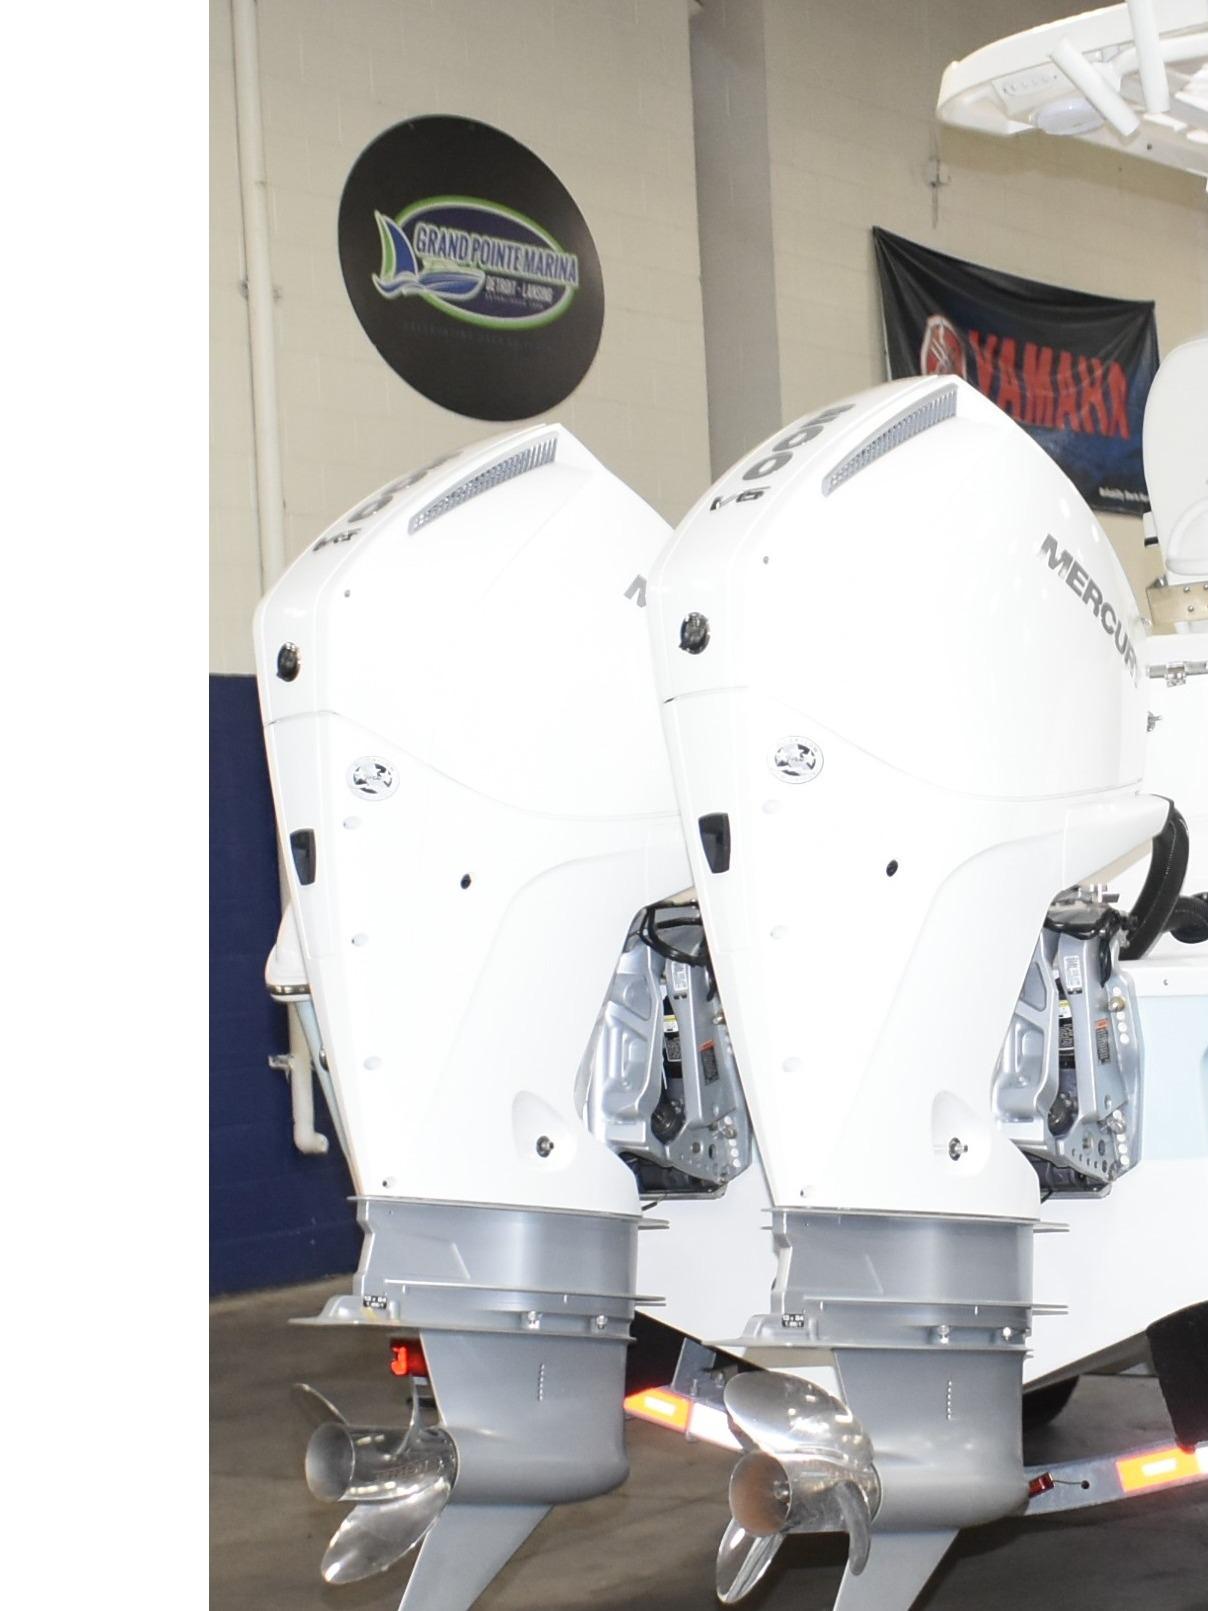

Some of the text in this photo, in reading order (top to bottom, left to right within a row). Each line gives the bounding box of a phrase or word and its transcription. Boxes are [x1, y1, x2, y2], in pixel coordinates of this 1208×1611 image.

[415, 223, 578, 285] GRAND POINTE MARINA
[968, 329, 1130, 441] YAMAHA
[1039, 533, 1139, 686] MERCUR
